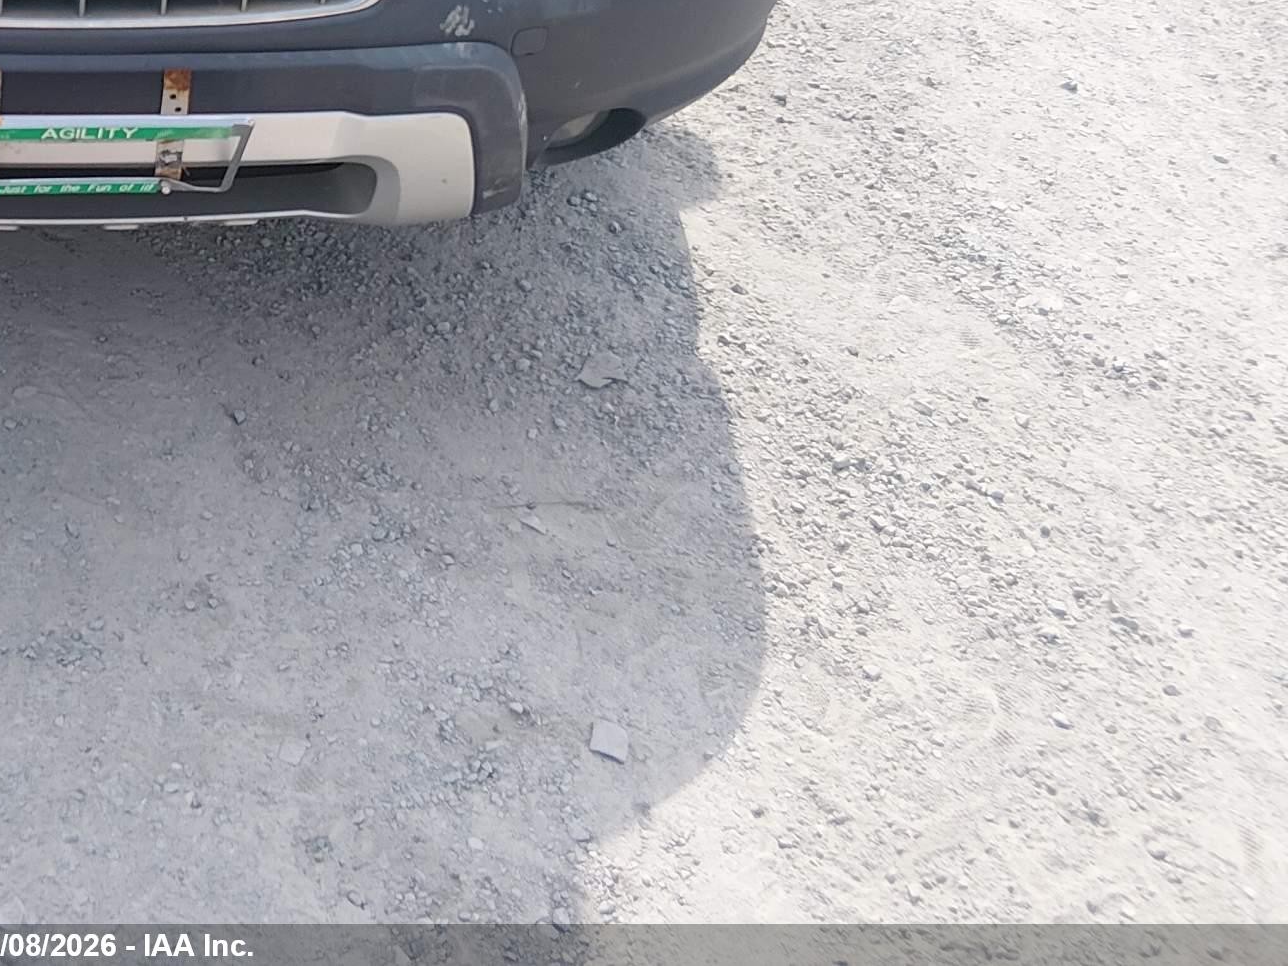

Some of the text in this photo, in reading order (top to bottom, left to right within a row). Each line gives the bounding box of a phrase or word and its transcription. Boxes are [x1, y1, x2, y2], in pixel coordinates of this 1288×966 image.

[40, 126, 139, 141] AGILITY
[0, 184, 27, 195] Just
[33, 184, 53, 194] for
[59, 184, 81, 194] the
[87, 183, 112, 194] Fun
[119, 183, 135, 193] of
